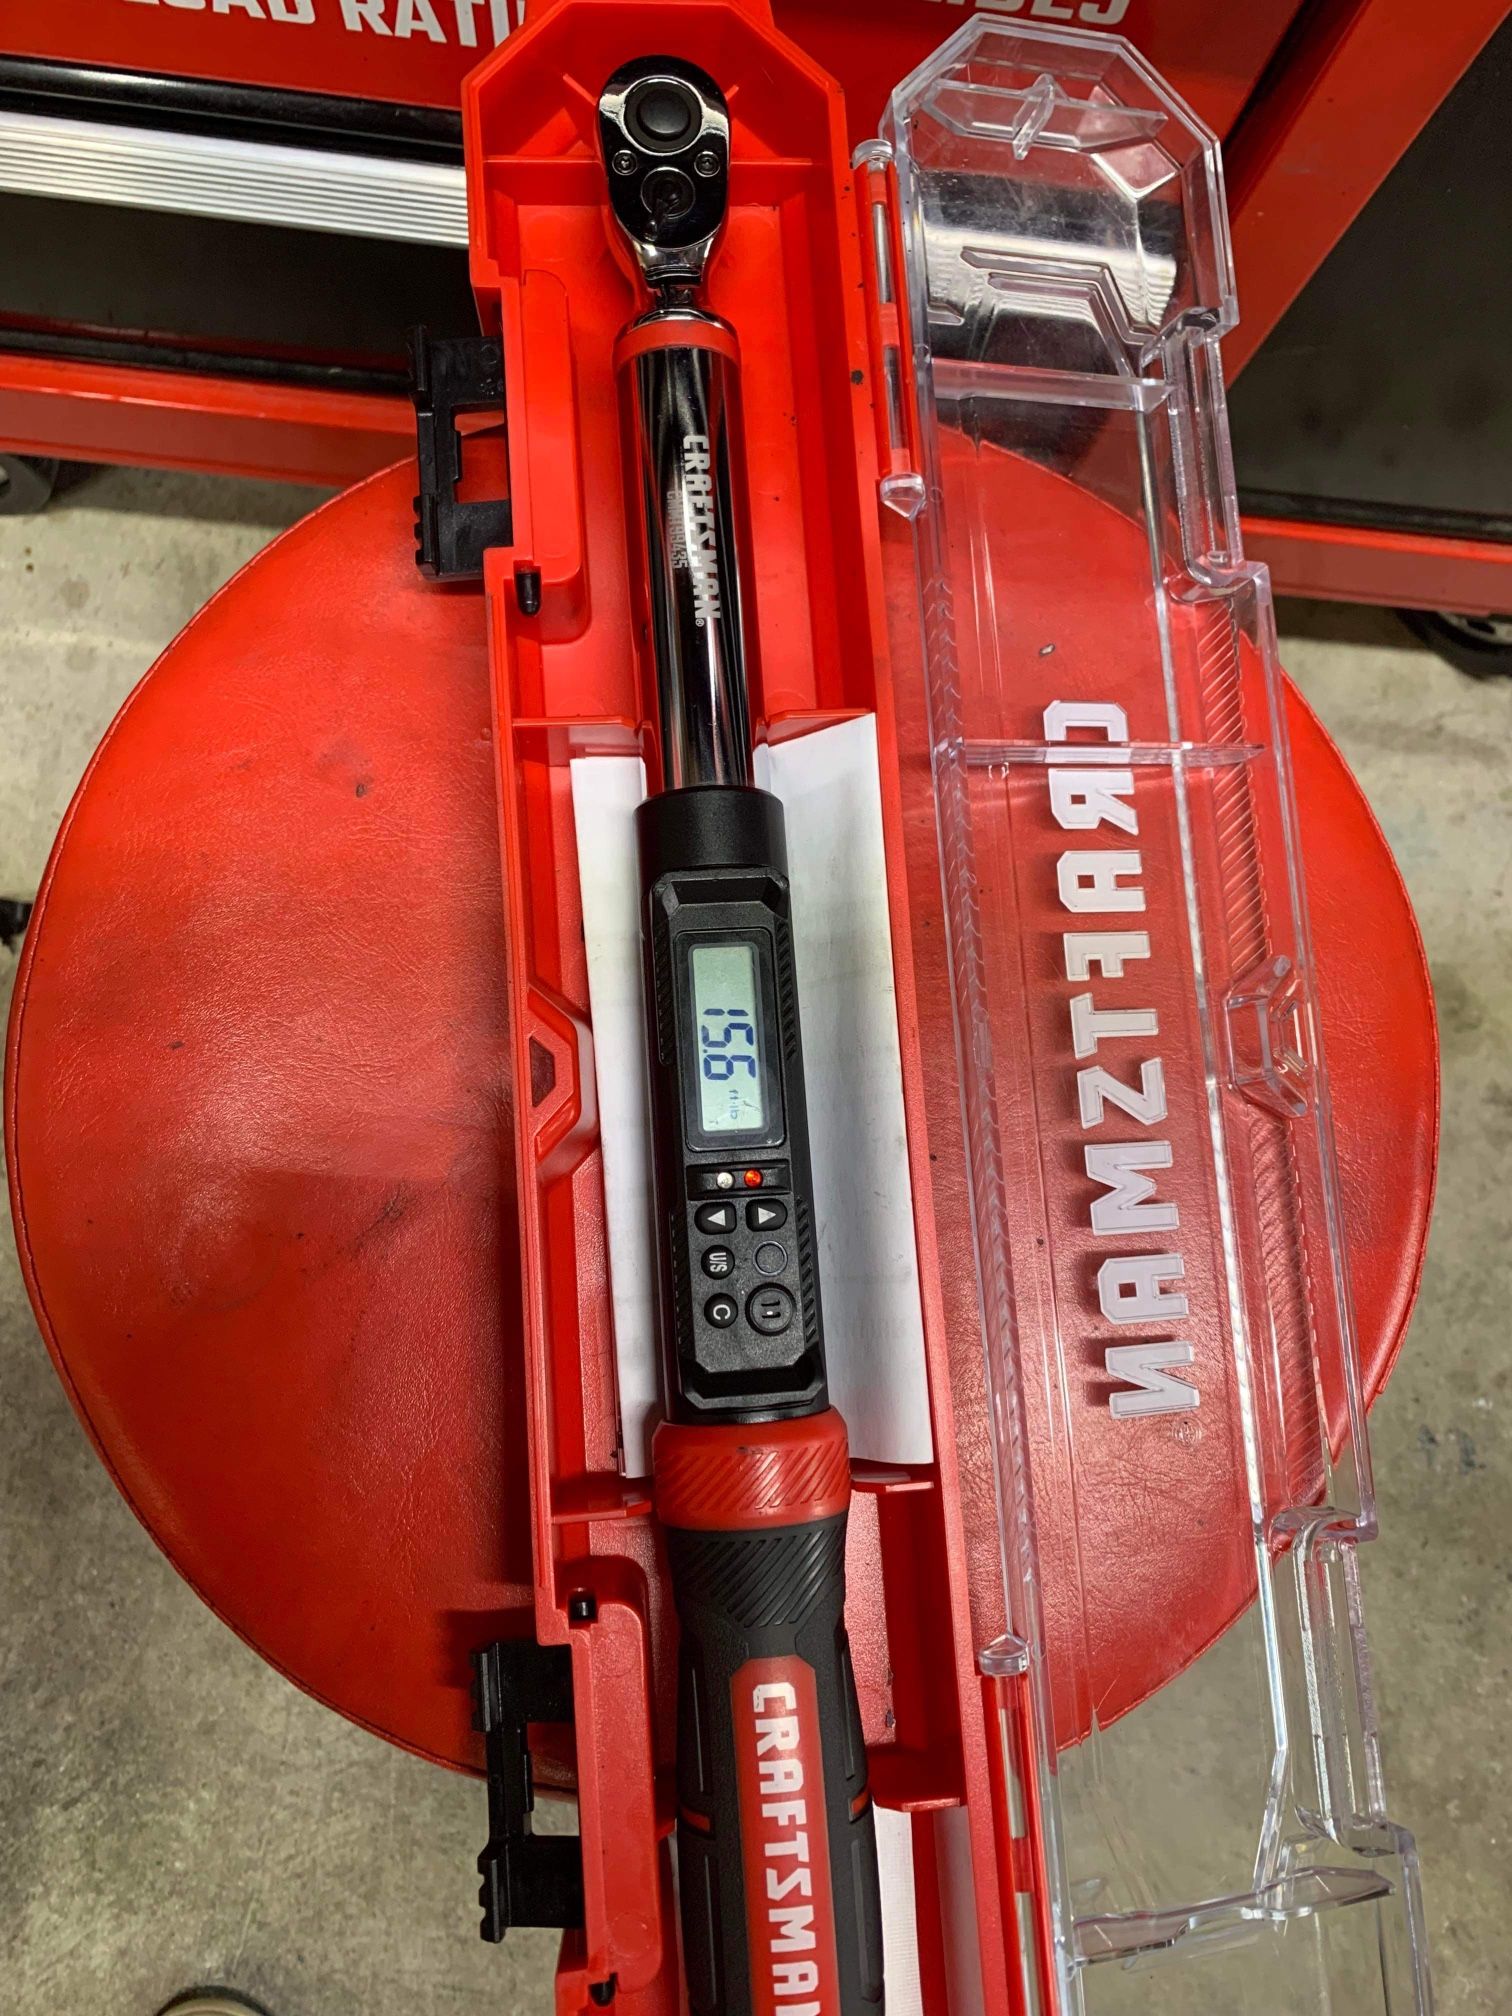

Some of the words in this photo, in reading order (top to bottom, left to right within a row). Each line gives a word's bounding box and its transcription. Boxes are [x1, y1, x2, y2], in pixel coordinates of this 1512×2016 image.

[340, 0, 526, 49] RATI
[702, 1007, 757, 1081] 15.6
[708, 1251, 728, 1274] U/S
[712, 1303, 731, 1321] C
